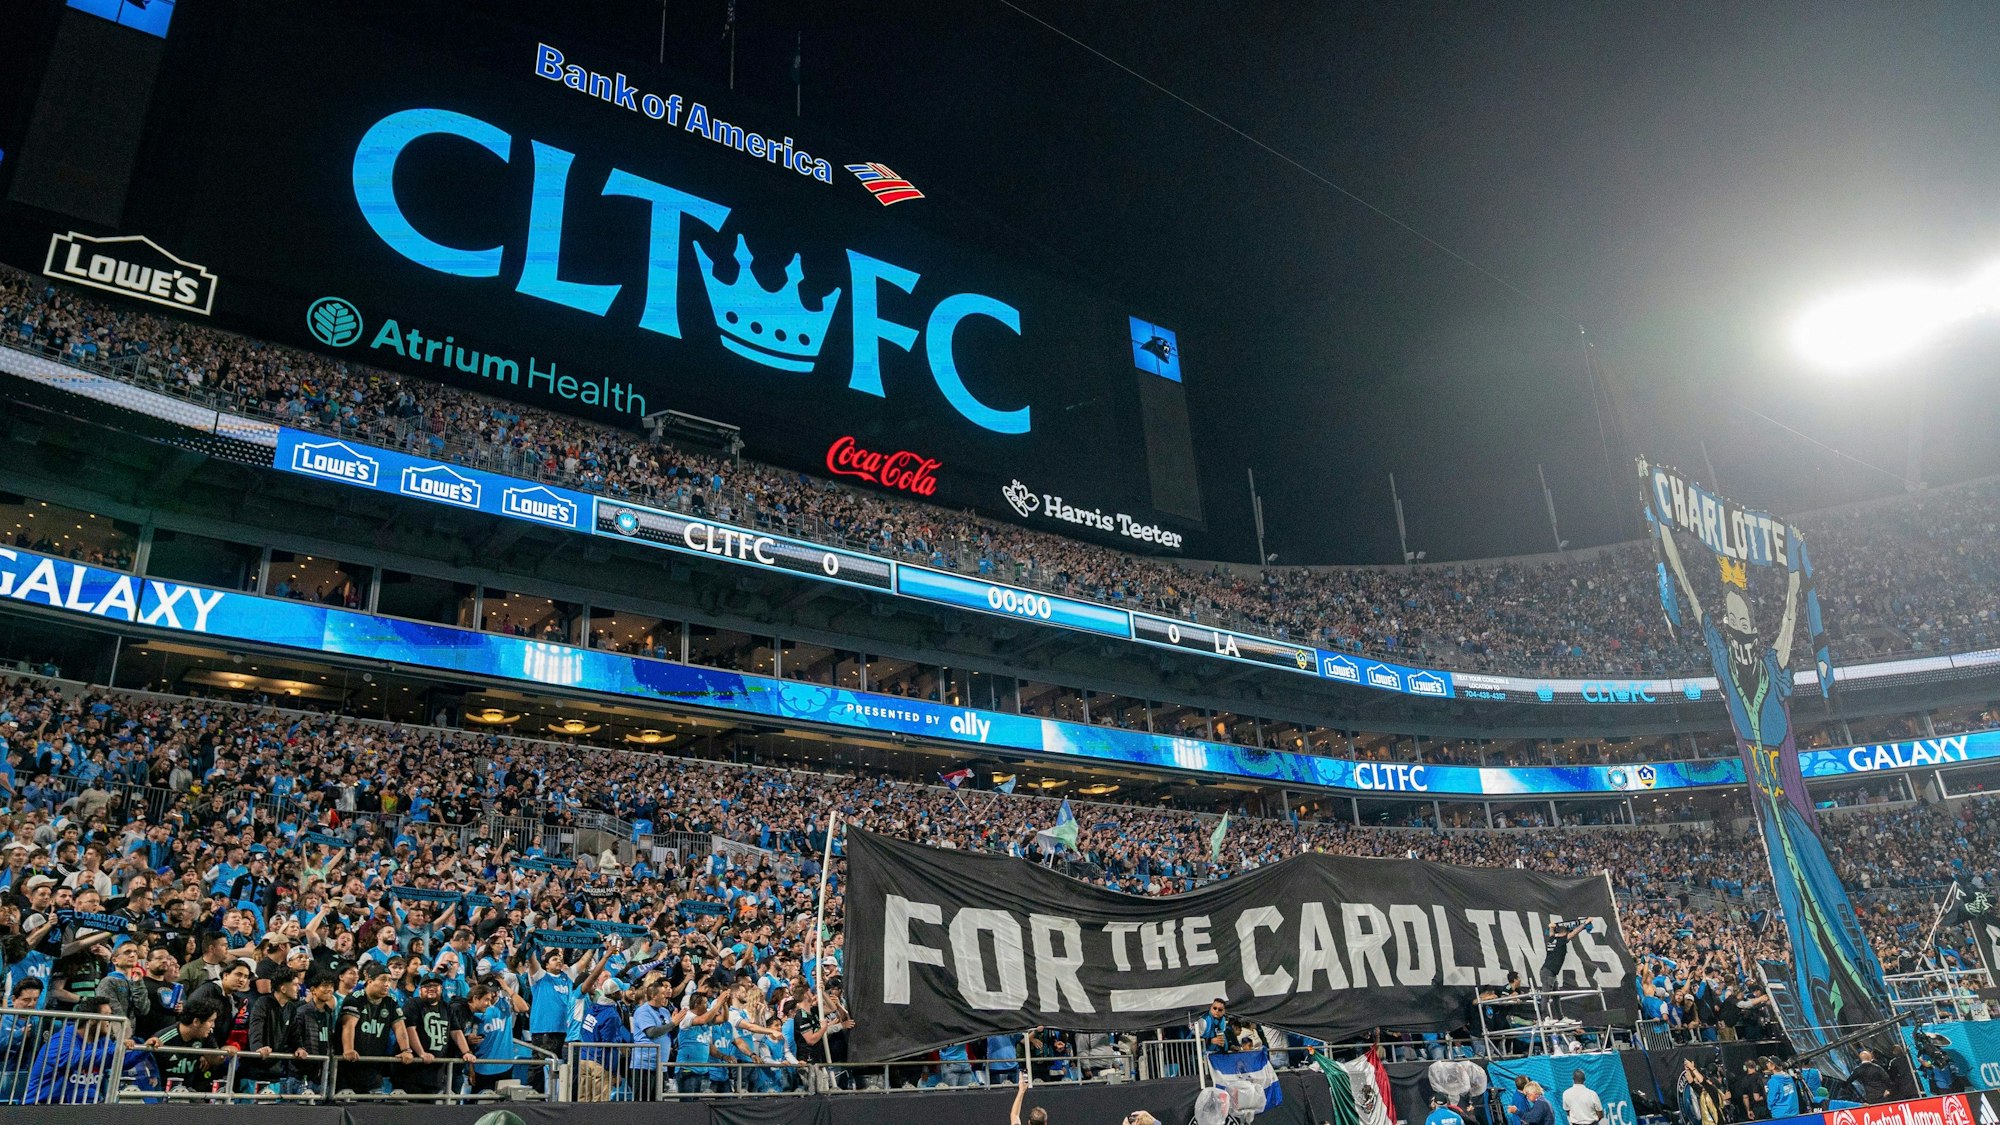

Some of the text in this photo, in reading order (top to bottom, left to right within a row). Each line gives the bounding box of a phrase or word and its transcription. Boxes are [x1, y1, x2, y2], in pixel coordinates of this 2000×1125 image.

[535, 43, 833, 184] Bank of America
[64, 243, 200, 305] LOWE'S
[370, 319, 646, 418] Atrium Health
[301, 453, 370, 482] LOWE'S
[826, 435, 942, 497] Coca-Cola
[408, 475, 473, 504] LOWE'S
[508, 496, 571, 523] LOWE'S
[1043, 495, 1183, 549] Harris Teeter
[1654, 472, 1788, 567] CHARLOTTE
[684, 521, 776, 566] CLTFC
[822, 553, 839, 576] 0
[987, 585, 1052, 620] 00:00
[1168, 624, 1181, 644] 0
[1213, 631, 1242, 658] LA
[1327, 661, 1357, 679] LOWE'S
[1371, 672, 1398, 687] LOWE'S
[846, 703, 940, 726] PRESENTED BY
[950, 711, 991, 744] ally
[1847, 735, 1969, 773] GALAXY
[1354, 762, 1429, 792] CLTFC
[543, 934, 556, 942] FOR
[884, 894, 1627, 1014] FOR THE CAROLINAS
[361, 1019, 385, 1038] ally
[484, 1017, 506, 1032] ally
